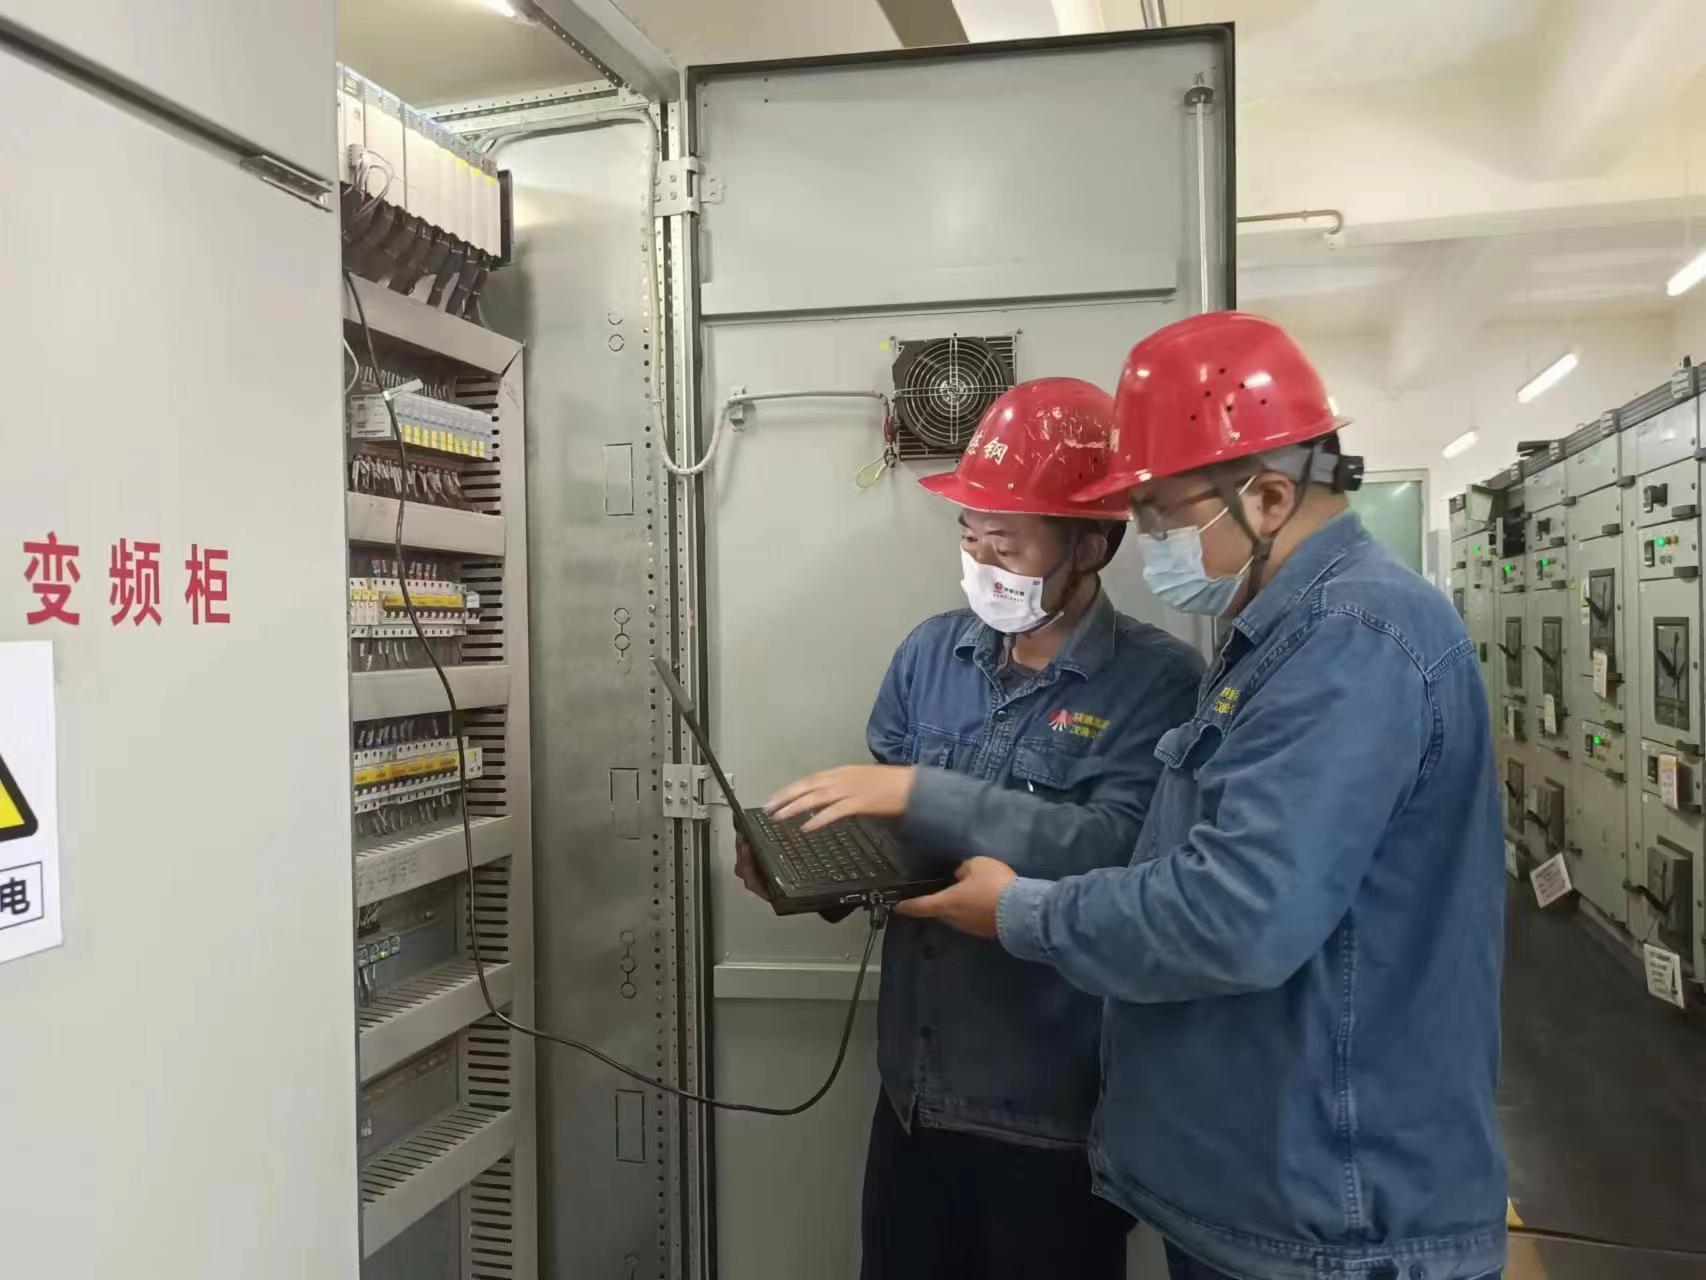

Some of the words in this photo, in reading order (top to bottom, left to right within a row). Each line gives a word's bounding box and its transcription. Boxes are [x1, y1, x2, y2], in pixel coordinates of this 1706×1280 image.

[23, 531, 231, 626] 变频柜
[0, 877, 30, 916] 电
